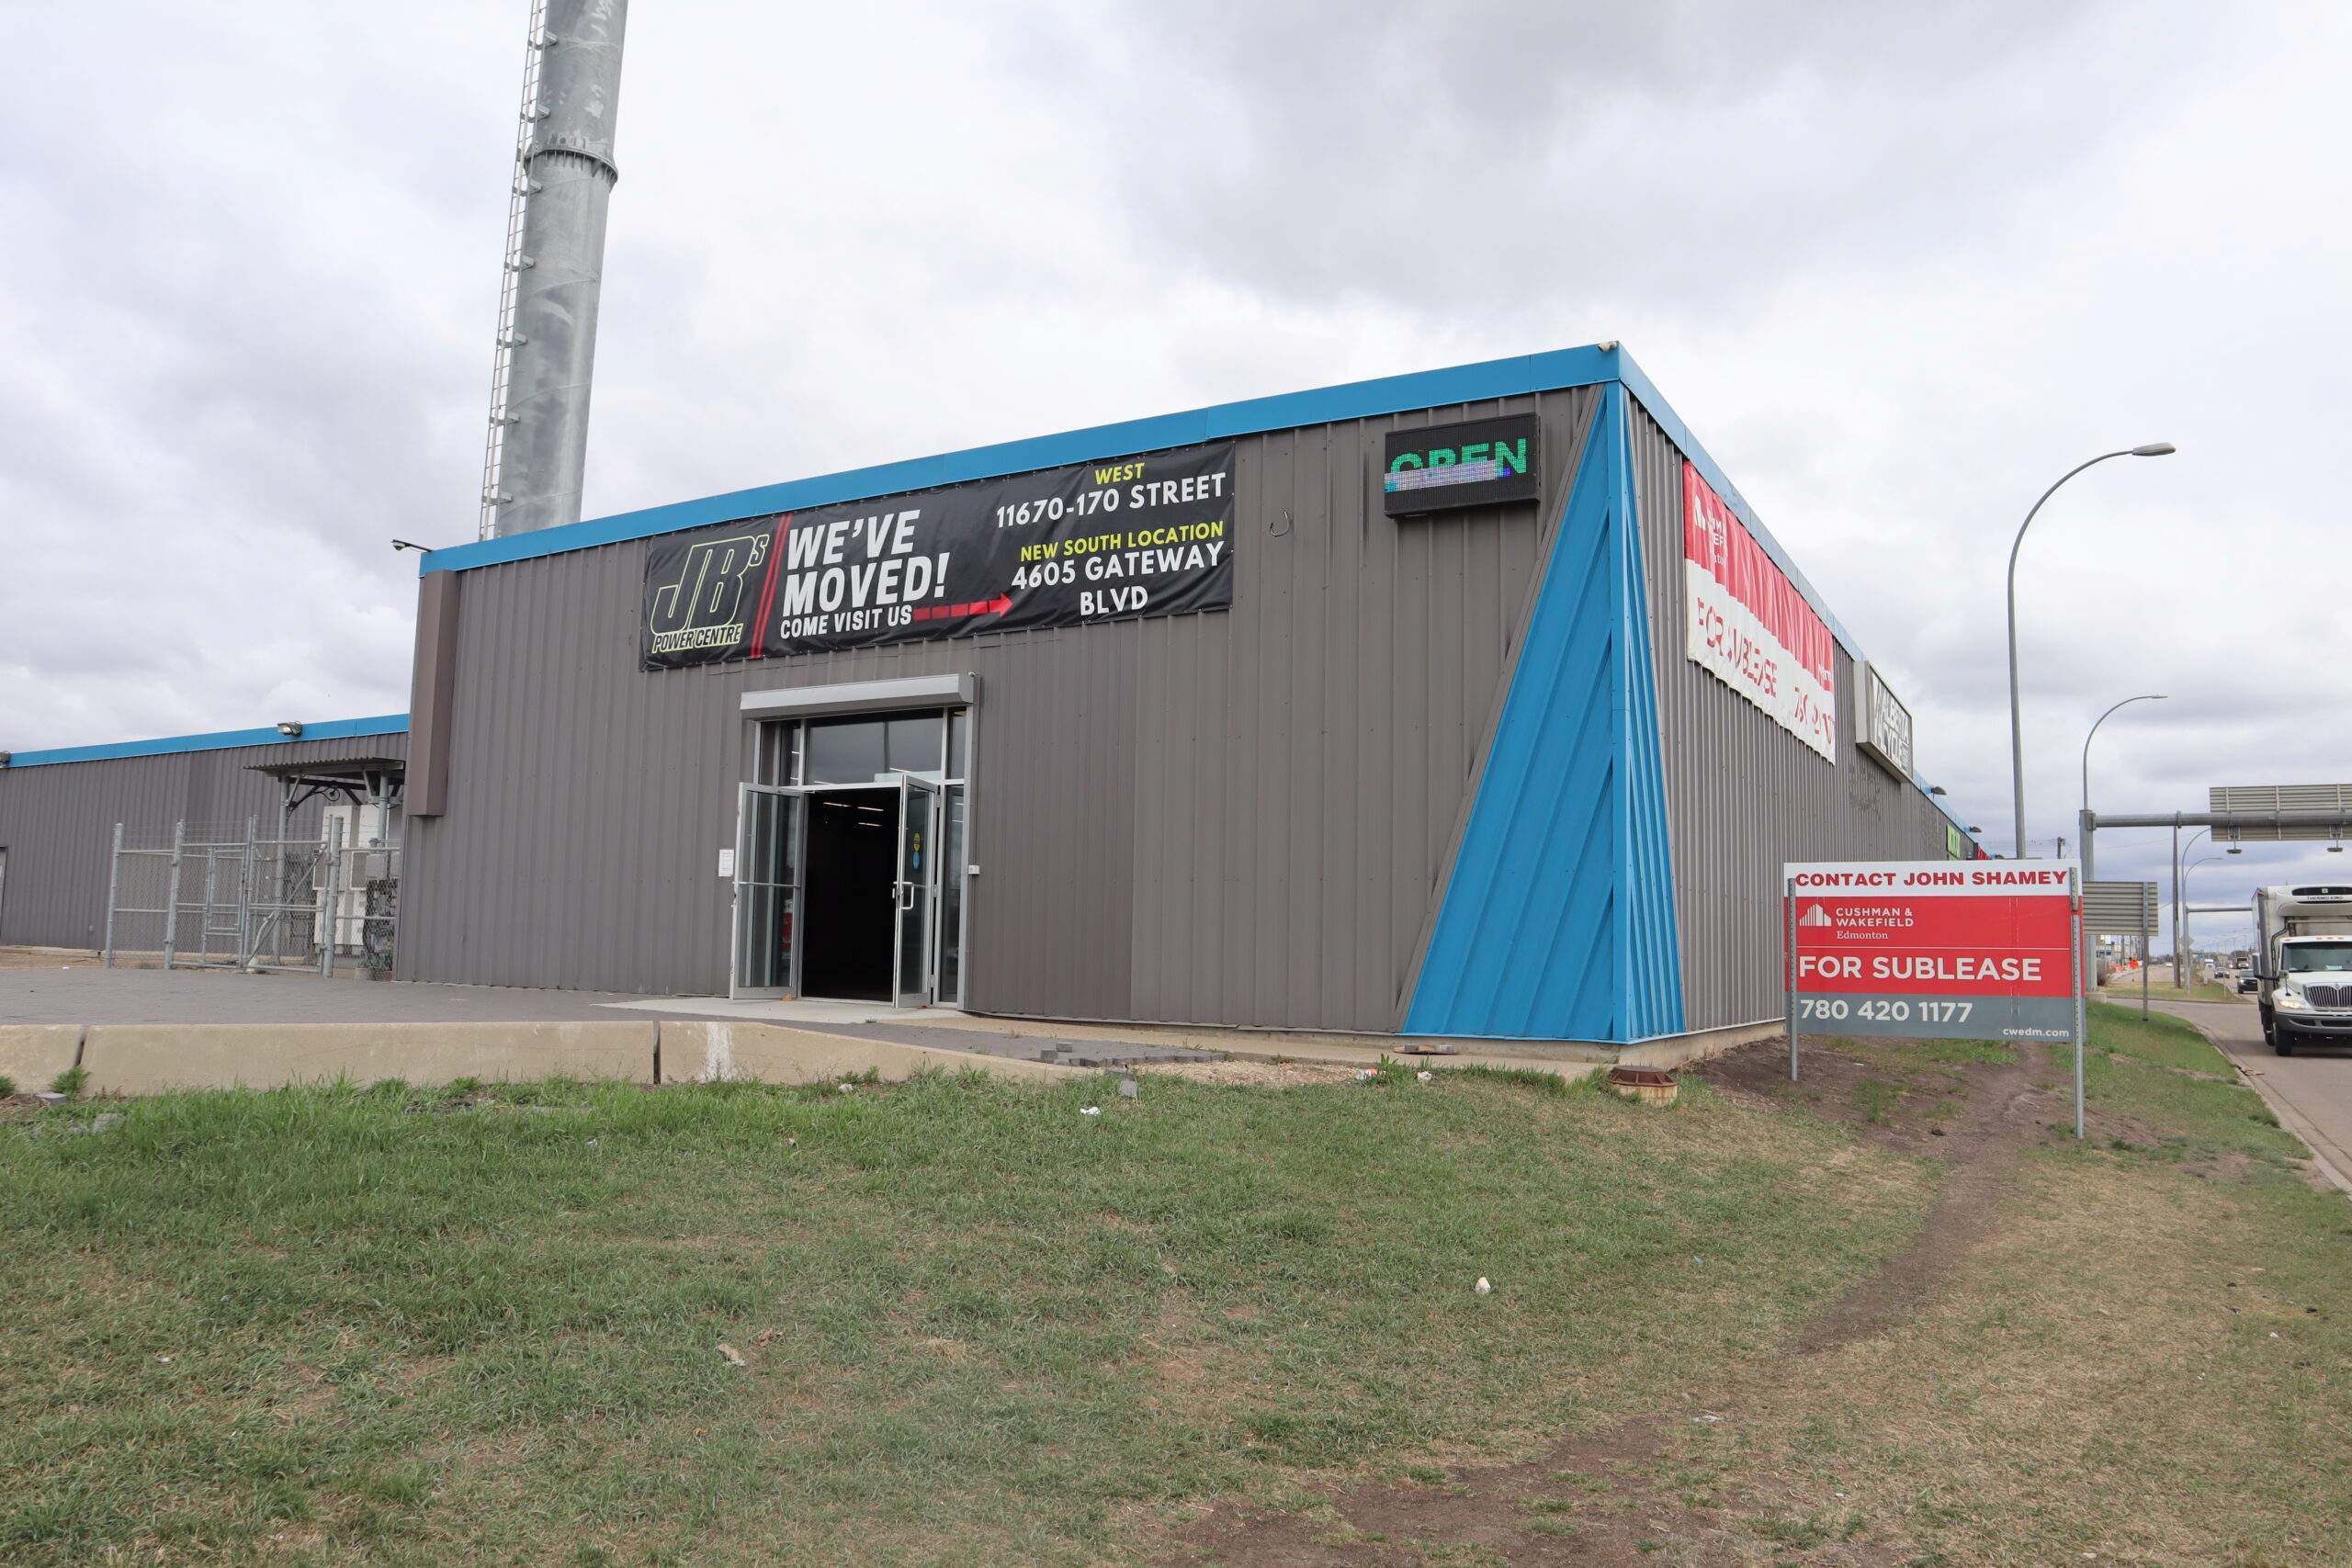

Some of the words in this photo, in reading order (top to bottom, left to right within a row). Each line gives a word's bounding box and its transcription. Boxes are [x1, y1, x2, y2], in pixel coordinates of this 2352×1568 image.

[1094, 462, 1146, 485] WEST
[996, 488, 1120, 528] 11670-170
[1129, 472, 1227, 509] STREET
[1021, 541, 1059, 562] NEW
[1064, 533, 1122, 557] SOUTH
[1128, 520, 1224, 547] LOCATION
[1011, 559, 1076, 590] 4605
[1085, 540, 1225, 581] GATEWAY
[783, 552, 951, 617] MOVED!
[1080, 585, 1148, 616] BLVD
[781, 614, 830, 639] COME
[834, 608, 883, 633] VISIT
[888, 604, 912, 627] US
[1795, 872, 1897, 887] CONTACT
[1904, 872, 1965, 886] JOHN
[1972, 871, 2067, 886] SHAMEY
[1836, 907, 1901, 918] CUSHMAN
[1905, 907, 1913, 918] &
[1836, 918, 1914, 928] WAKEFIELD
[1837, 931, 1889, 940] Edmonton
[1799, 955, 1862, 979] FOR
[1872, 957, 2042, 981] SUBLEASE
[1800, 998, 1849, 1021] 780
[1858, 1000, 1910, 1022] 420
[1918, 1001, 1973, 1023] 1177
[2003, 1027, 2069, 1038] cwedm.com
